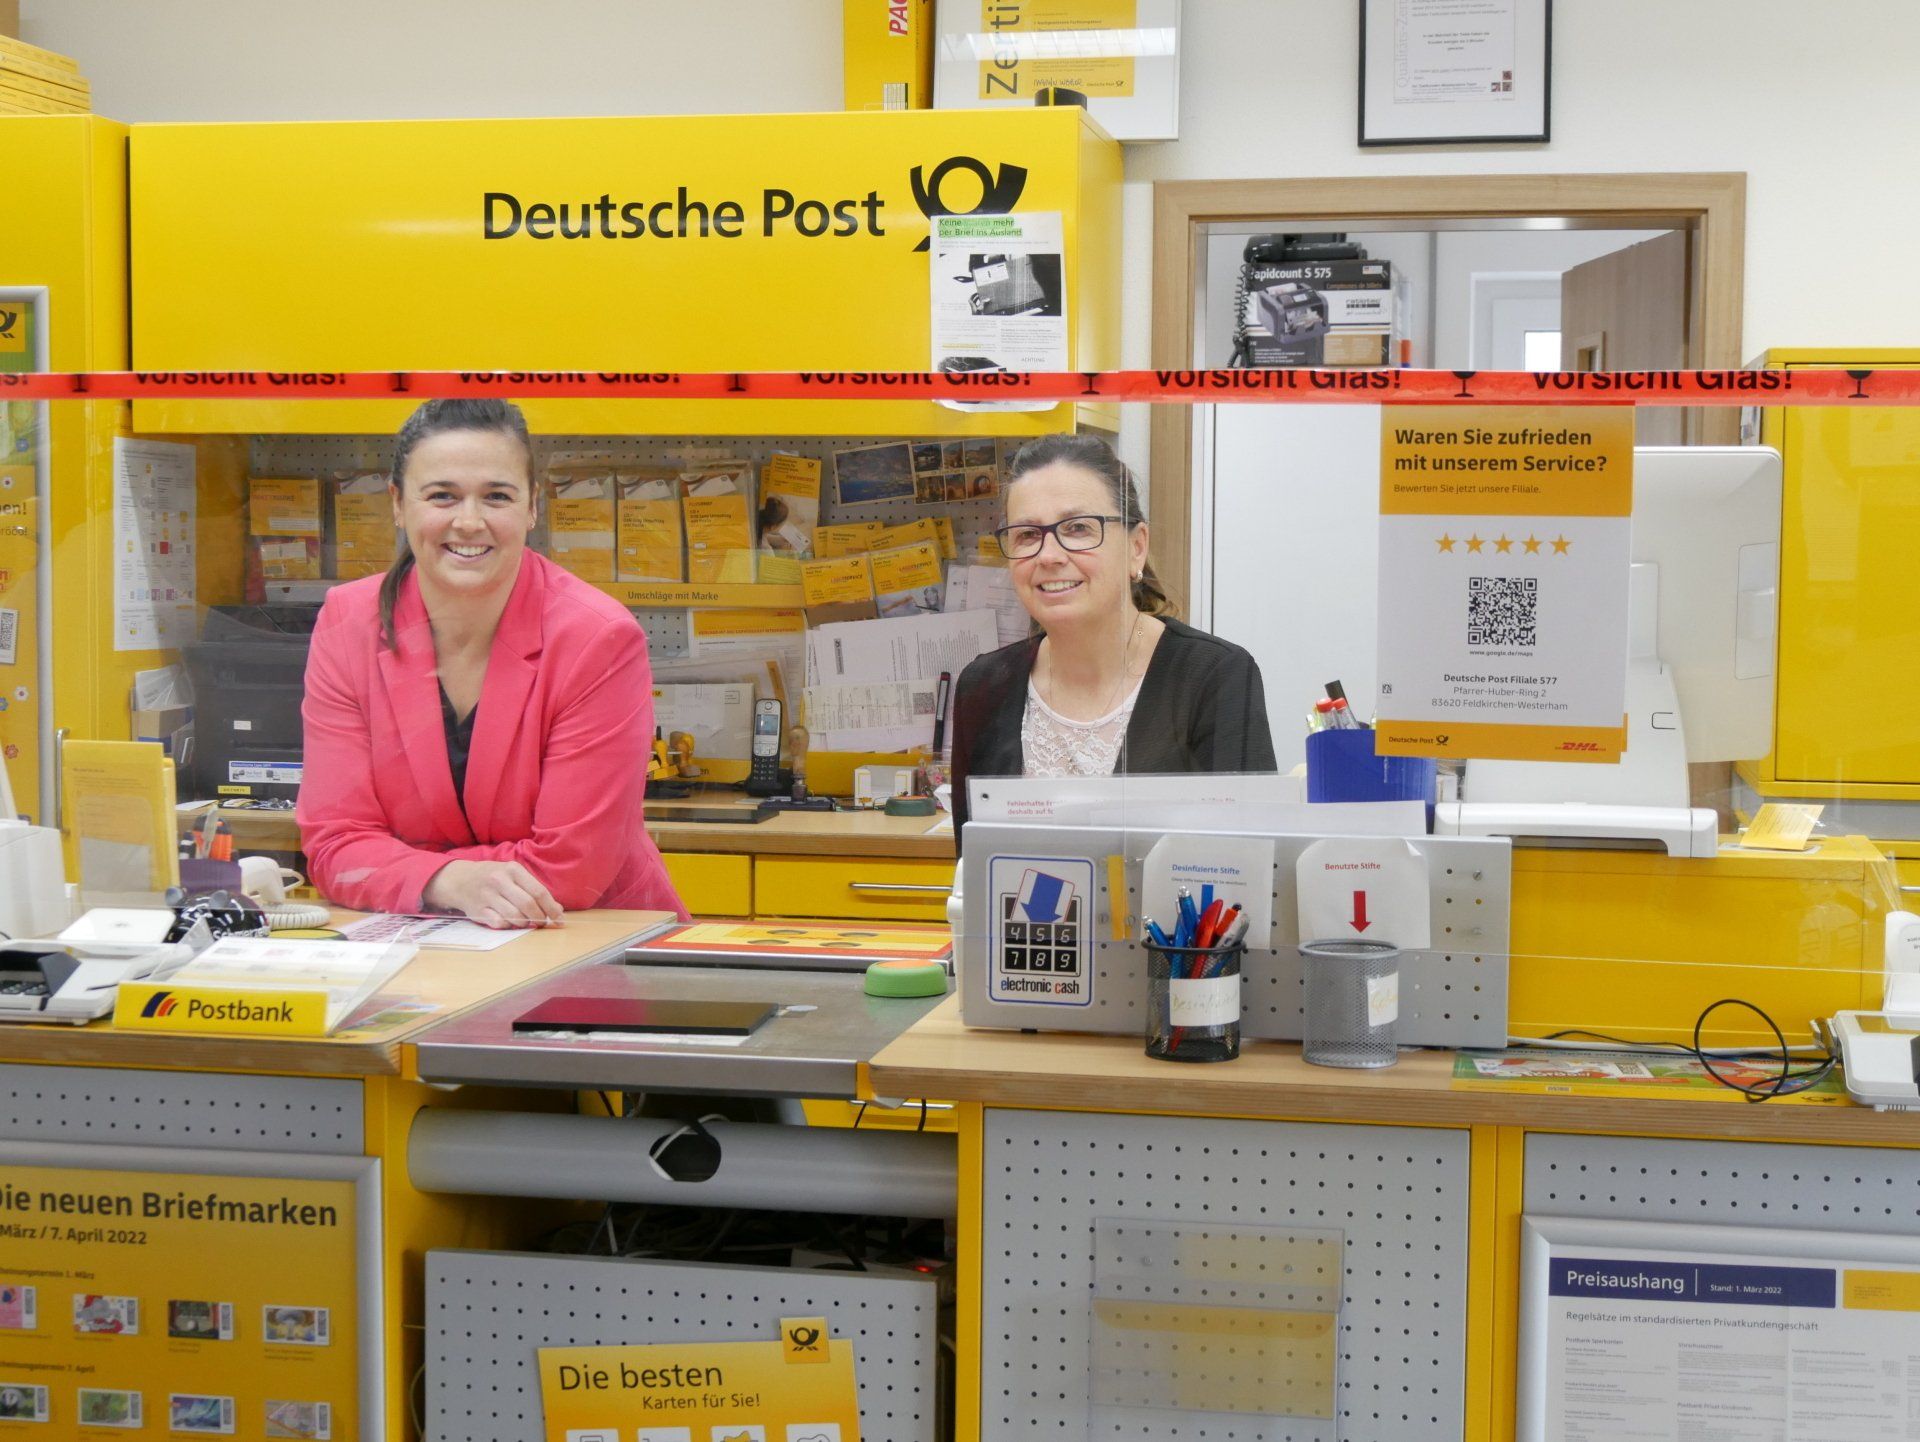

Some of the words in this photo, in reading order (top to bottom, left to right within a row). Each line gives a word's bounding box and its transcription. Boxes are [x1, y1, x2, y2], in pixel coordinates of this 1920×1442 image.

[484, 187, 743, 240] Deutsche
[763, 190, 885, 237] Post
[939, 219, 962, 227] Keine
[993, 218, 1015, 227] mehr
[939, 229, 953, 238] per
[955, 228, 974, 236] Brief
[976, 228, 988, 236] ins
[990, 227, 1023, 237] Ausland
[1304, 267, 1312, 279] S
[1314, 267, 1332, 279] 575
[1309, 371, 1401, 389] Glas!
[1696, 371, 1792, 389] Glas!
[1395, 429, 1458, 445] Waren
[1463, 428, 1493, 445] Sie
[1498, 428, 1592, 446] zufrieden
[1395, 454, 1427, 470] mit
[1432, 456, 1517, 471] unserem
[1523, 455, 1608, 472] Service?
[1394, 484, 1438, 493] Bewerten
[1440, 484, 1454, 493] Sie
[1455, 485, 1477, 495] jetzt
[1478, 485, 1510, 494] unsere
[1512, 485, 1542, 494] Filiale.
[0, 503, 27, 516] en!
[628, 591, 672, 602] Umschläge
[675, 591, 690, 600] mit
[692, 592, 719, 601] Marke
[1469, 650, 1533, 658] www.google.de/maps
[1444, 674, 1486, 684] Deutsche
[1488, 675, 1509, 684] Post
[1511, 675, 1538, 685] Filiale
[1540, 676, 1557, 685] 577
[1453, 687, 1539, 699] Pfarrer-Huber-Ring
[1540, 689, 1547, 697] 2
[1431, 698, 1461, 707] 83620
[1463, 699, 1568, 710] Feldkirchen-Westerham
[1389, 736, 1418, 744] Deutsche
[1561, 742, 1599, 751] DHL
[1172, 864, 1218, 874] Desinfizierte
[1220, 866, 1240, 875] Stifte
[1325, 863, 1359, 871] Benutzte
[1011, 926, 1021, 941] 4
[1036, 927, 1045, 942] 5
[1061, 928, 1070, 943] 6
[1011, 951, 1019, 966] 7
[1035, 952, 1046, 967] 8
[1060, 953, 1070, 968] 9
[1001, 977, 1051, 993] electronic
[1055, 980, 1079, 994] cash
[188, 999, 293, 1023] Postbank
[0, 1184, 31, 1211] ie
[40, 1189, 133, 1217] neuen
[142, 1191, 337, 1227] Briefmarken
[0, 1224, 36, 1239] März
[51, 1227, 63, 1241] 7.
[66, 1227, 104, 1245] April
[108, 1230, 148, 1245] 2022
[1567, 1270, 1684, 1294] Preisaushang
[1710, 1284, 1733, 1293] Stand:
[1735, 1285, 1741, 1293] 1.
[1743, 1285, 1762, 1294] März
[1764, 1286, 1782, 1295] 2022
[1566, 1311, 1617, 1323] Regelsätze
[1620, 1314, 1631, 1322] im
[1633, 1314, 1712, 1327] standardisierten
[1714, 1318, 1819, 1331] Privatkundengeschäft
[559, 1364, 609, 1390] Die
[620, 1362, 723, 1388] besten
[643, 1395, 697, 1410] Karten
[703, 1392, 726, 1408] für
[732, 1393, 761, 1408] Sie!
